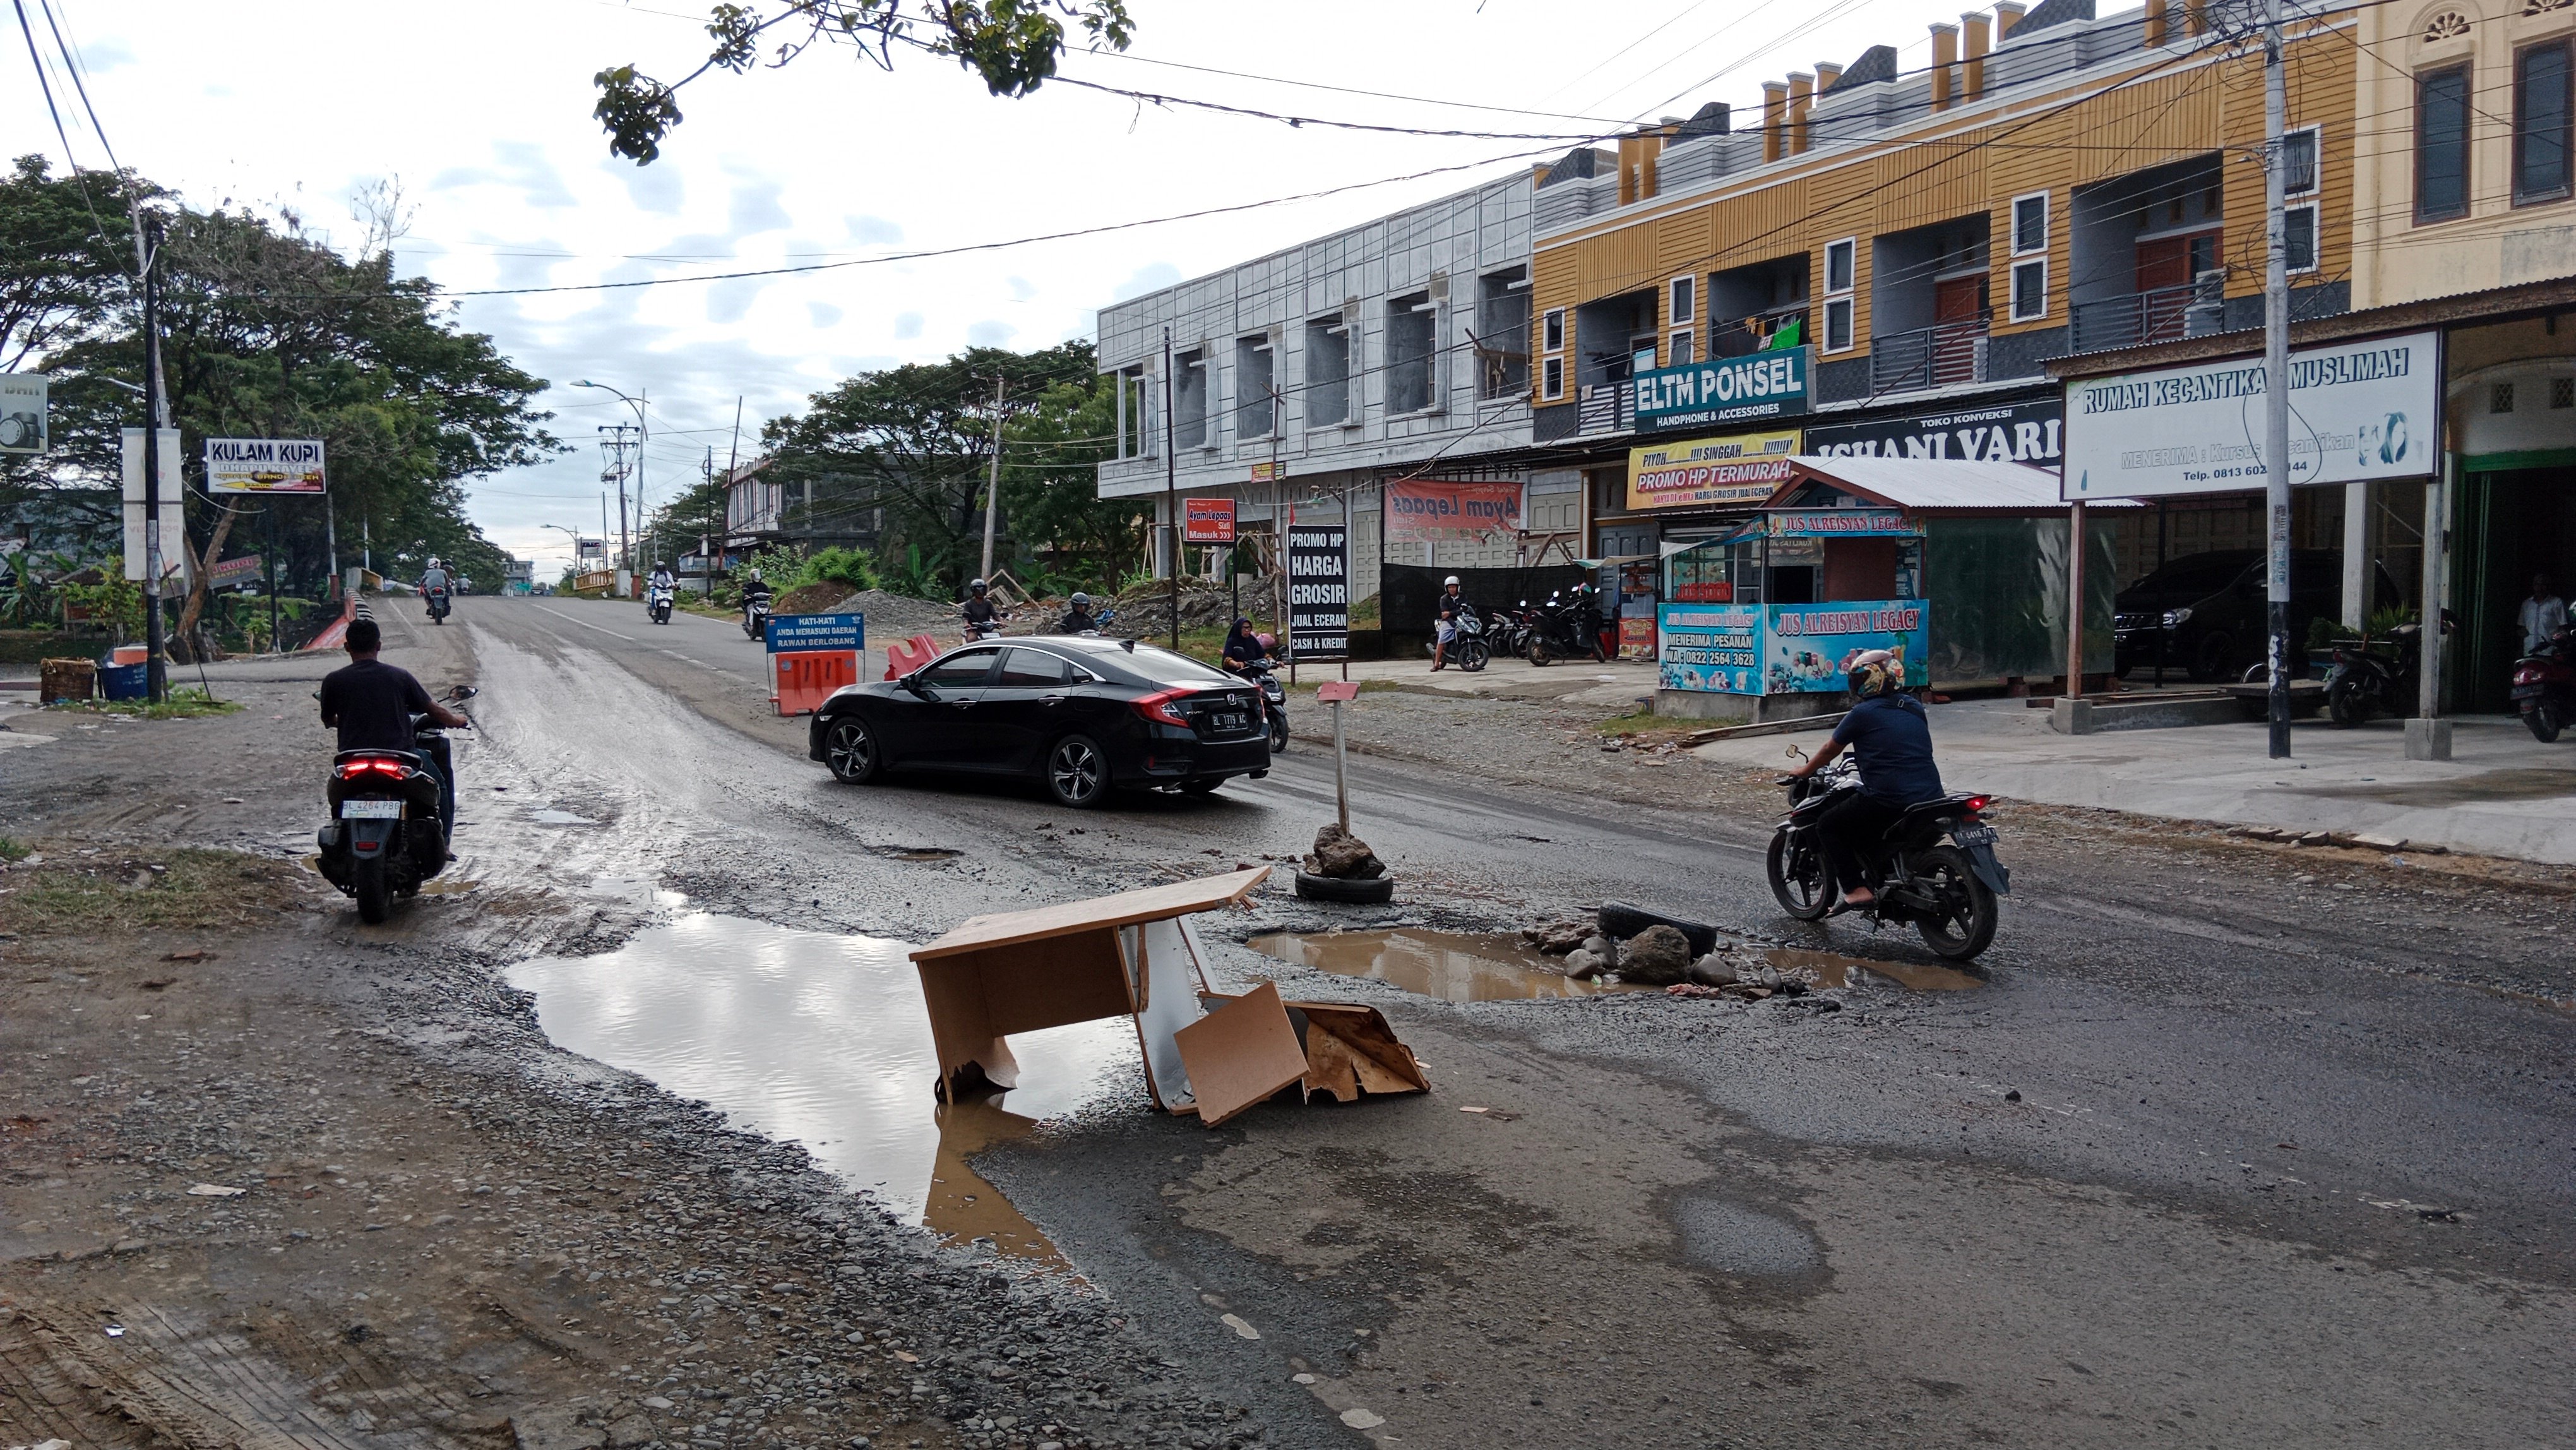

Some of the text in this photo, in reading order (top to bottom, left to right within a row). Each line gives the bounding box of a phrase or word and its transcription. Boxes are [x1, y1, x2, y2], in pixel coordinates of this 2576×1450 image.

[1637, 357, 1802, 411] ELTM PONSEL
[2084, 347, 2409, 414] RUMAH KECANTIKA MUSLIMAH
[1657, 403, 1780, 428] HANDPHONE & ACCESSORIES
[1920, 409, 2012, 428] TOKO KONVEKSI
[211, 441, 320, 462] KULAM KUPI
[1703, 444, 1743, 461] SINGGAH
[2121, 446, 2198, 469] MENERIMA
[2210, 442, 2262, 462] Kursus
[2266, 433, 2354, 457] cantikan
[1637, 460, 1791, 491] PROMO HP TERMURAH
[2183, 472, 2210, 482] Telp.
[2214, 468, 2243, 479] 0813
[1713, 489, 1737, 499] GROSIR
[1189, 508, 1231, 523] Ayam Lepaas
[1784, 517, 1805, 532] JUS
[1808, 517, 1868, 532] ALREISYAN
[1189, 531, 1218, 539] Masuk
[1290, 533, 1344, 548] PROMO HP
[1292, 556, 1343, 576] HARGA
[1291, 584, 1345, 604] GROSIR
[799, 617, 836, 626] HATI-HATI
[1291, 614, 1346, 626] JUAL ECERAN
[1666, 612, 1681, 626] JUS
[1723, 613, 1755, 627] LEGACY
[1777, 609, 1920, 635] JUS ALREISYAN LEGACY
[1292, 637, 1347, 650] CASH & KREDIT
[1667, 633, 1753, 649] MENERIMA PESANAN
[1666, 650, 1679, 663] WA
[1686, 650, 1707, 664] 0822
[1708, 651, 1731, 665] 2564
[1732, 652, 1755, 666] 3628
[1224, 715, 1236, 724] 1779
[343, 801, 353, 810] BL
[357, 801, 379, 810] 4264
